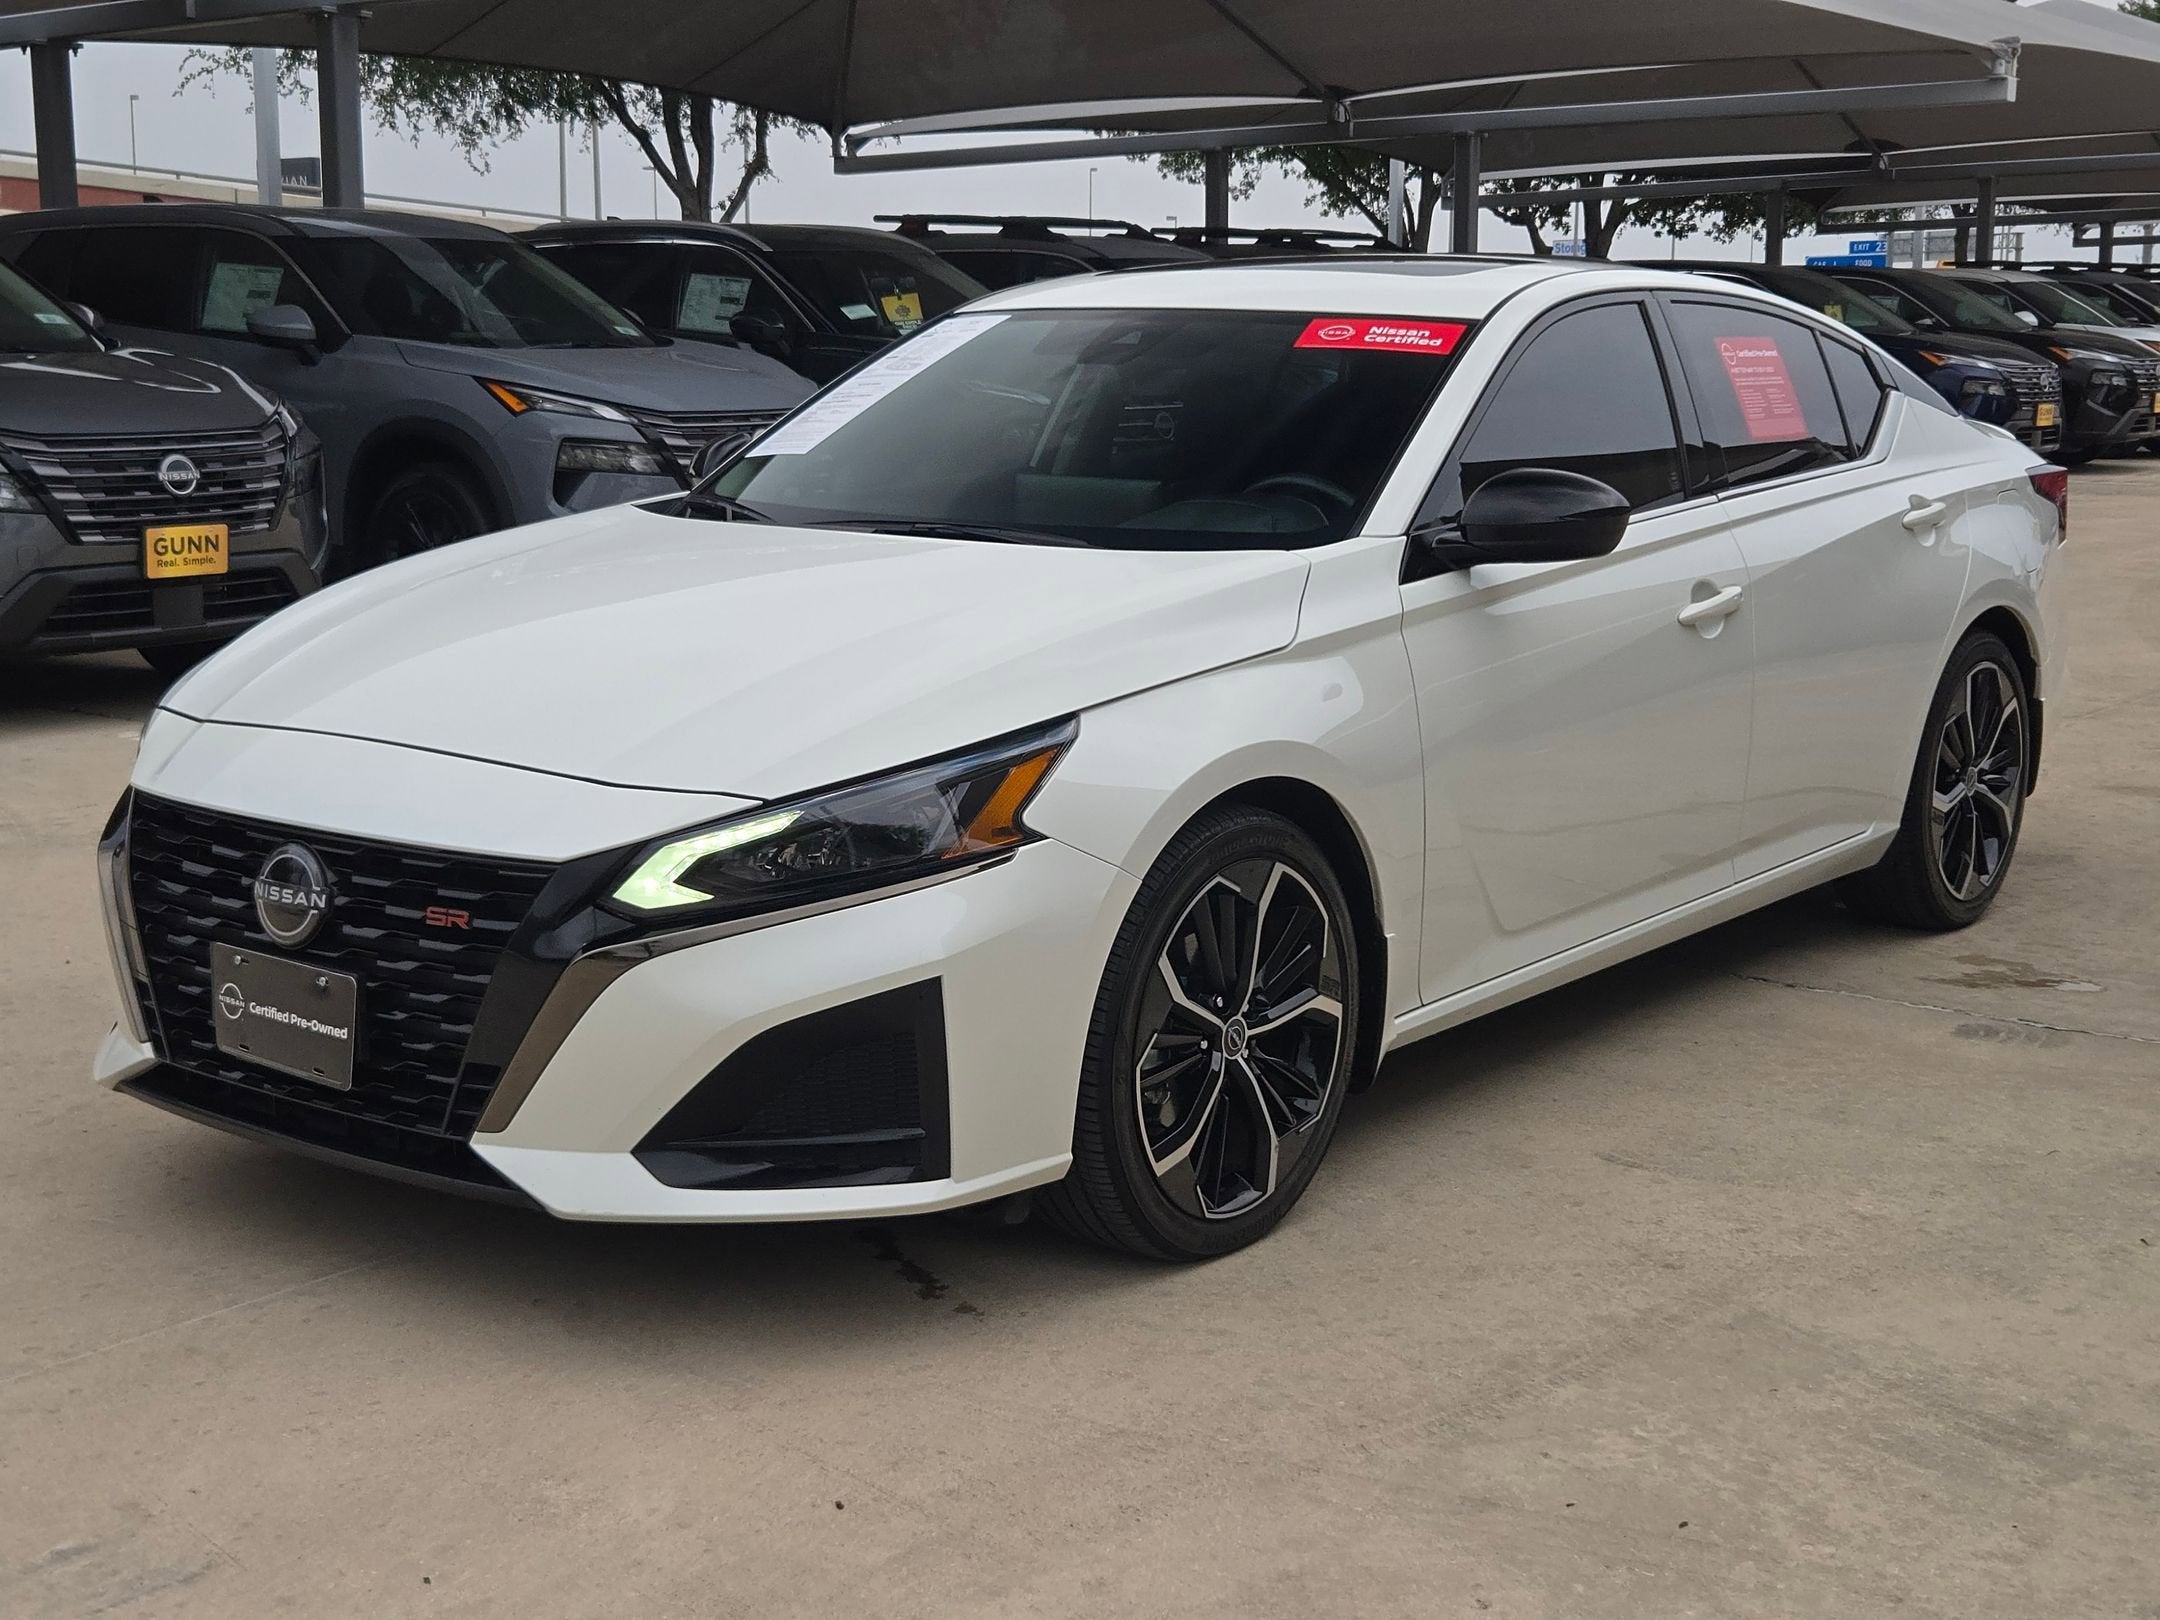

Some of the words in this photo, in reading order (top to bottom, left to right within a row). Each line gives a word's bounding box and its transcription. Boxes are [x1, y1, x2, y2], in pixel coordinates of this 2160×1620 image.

[1368, 326, 1431, 337] Nissan
[1363, 334, 1444, 346] Certified
[158, 472, 200, 481] NISSAN
[153, 535, 219, 556] GUNN
[157, 559, 180, 568] Real.
[183, 555, 217, 567] Simple.
[254, 880, 326, 908] NISSAN
[426, 906, 470, 930] SR
[219, 994, 245, 1008] NISSAN
[249, 1002, 289, 1023] Certified
[290, 1013, 348, 1039] Pre-Owned
